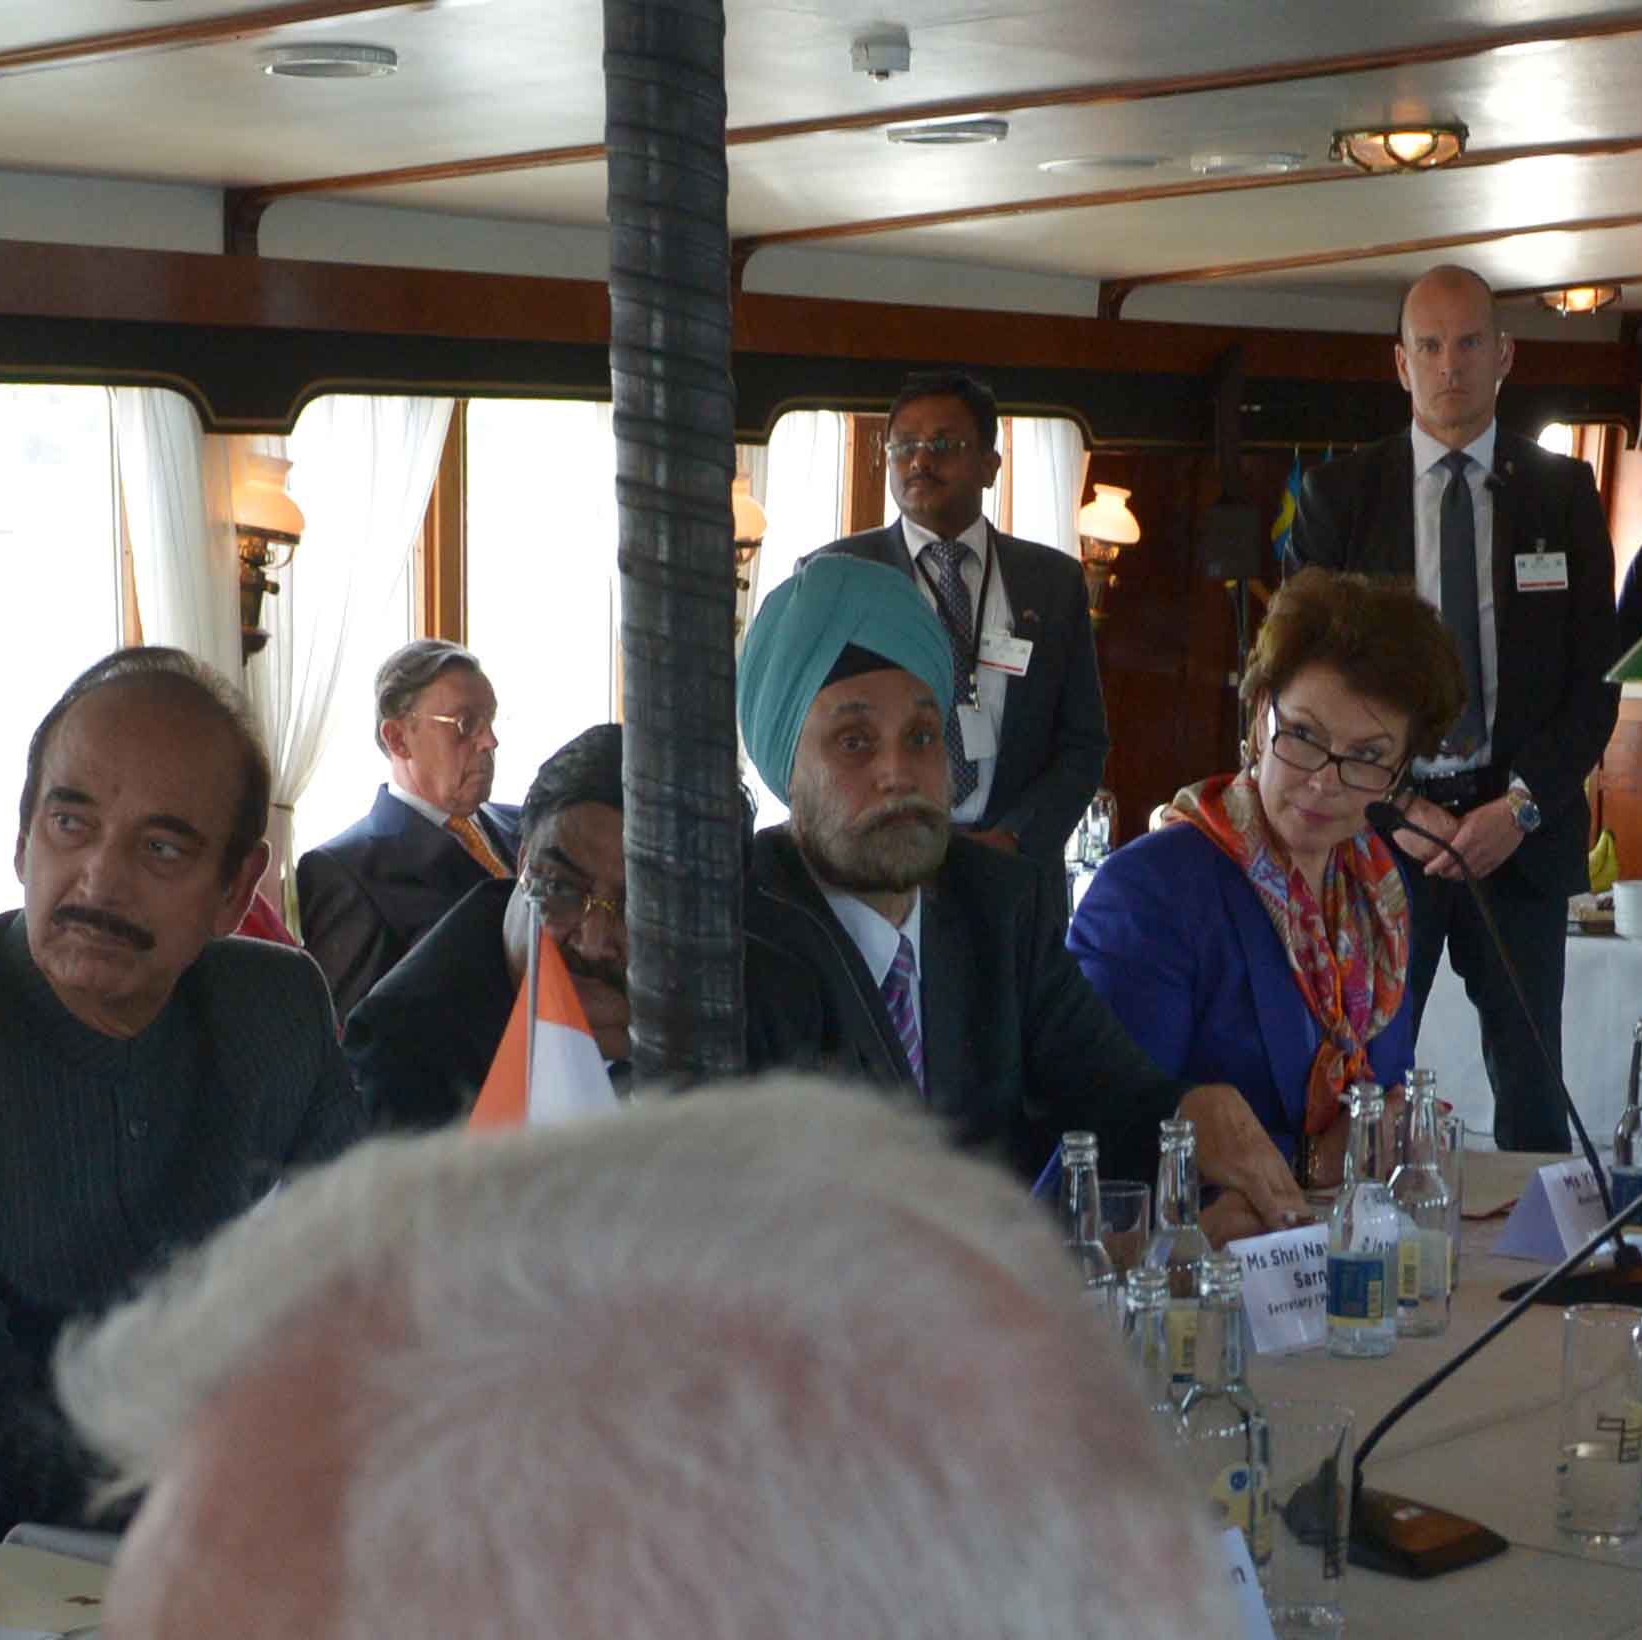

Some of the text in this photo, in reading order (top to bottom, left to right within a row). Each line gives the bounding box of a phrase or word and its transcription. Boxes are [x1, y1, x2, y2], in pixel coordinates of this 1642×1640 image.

[1246, 1252, 1268, 1271] Ms
[1270, 1245, 1300, 1267] Shri
[1293, 1268, 1328, 1289] Sarn
